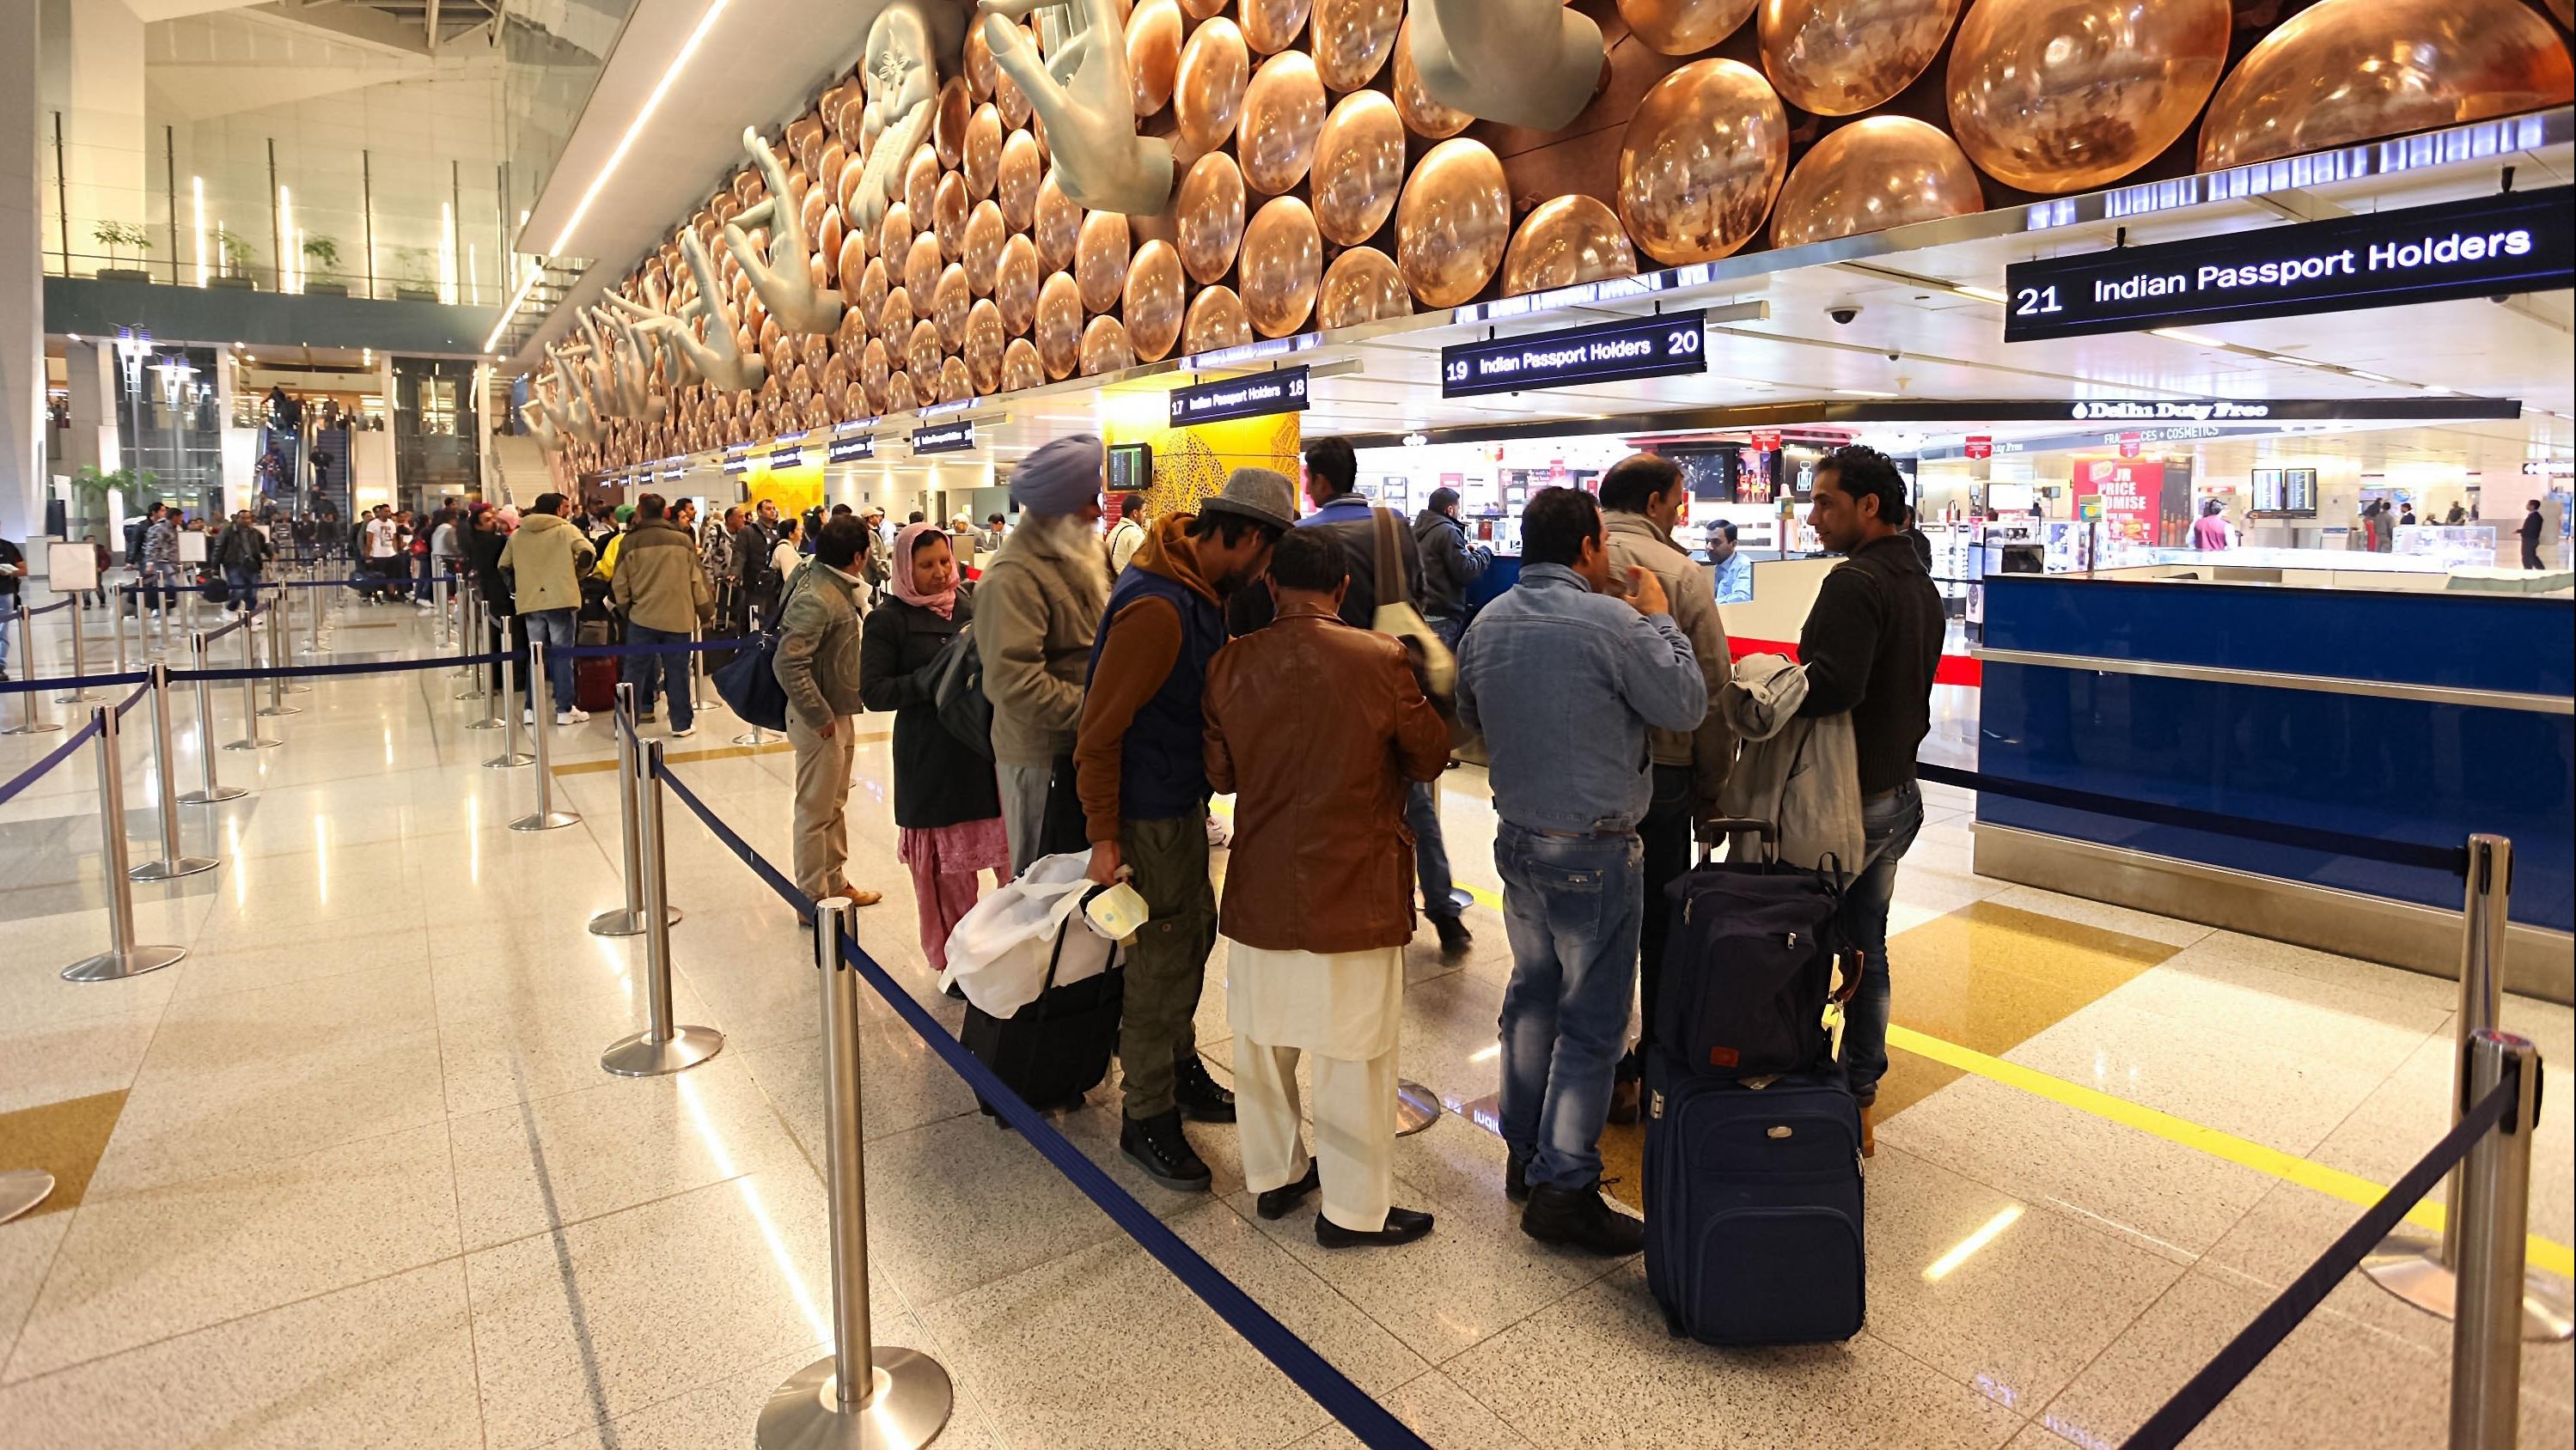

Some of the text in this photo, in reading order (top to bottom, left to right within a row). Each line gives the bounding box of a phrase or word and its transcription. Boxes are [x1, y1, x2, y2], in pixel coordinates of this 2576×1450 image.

[2016, 229, 2531, 315] 21 Indian Passport Holders
[1446, 330, 1699, 381] 19 Indian Passport Holders 20
[1171, 400, 1183, 416] 17
[1248, 385, 1281, 401] Holders
[1289, 379, 1305, 397] 18
[2088, 402, 2269, 421] Delhi Duty Free
[2166, 426, 2219, 441] COSMETICS
